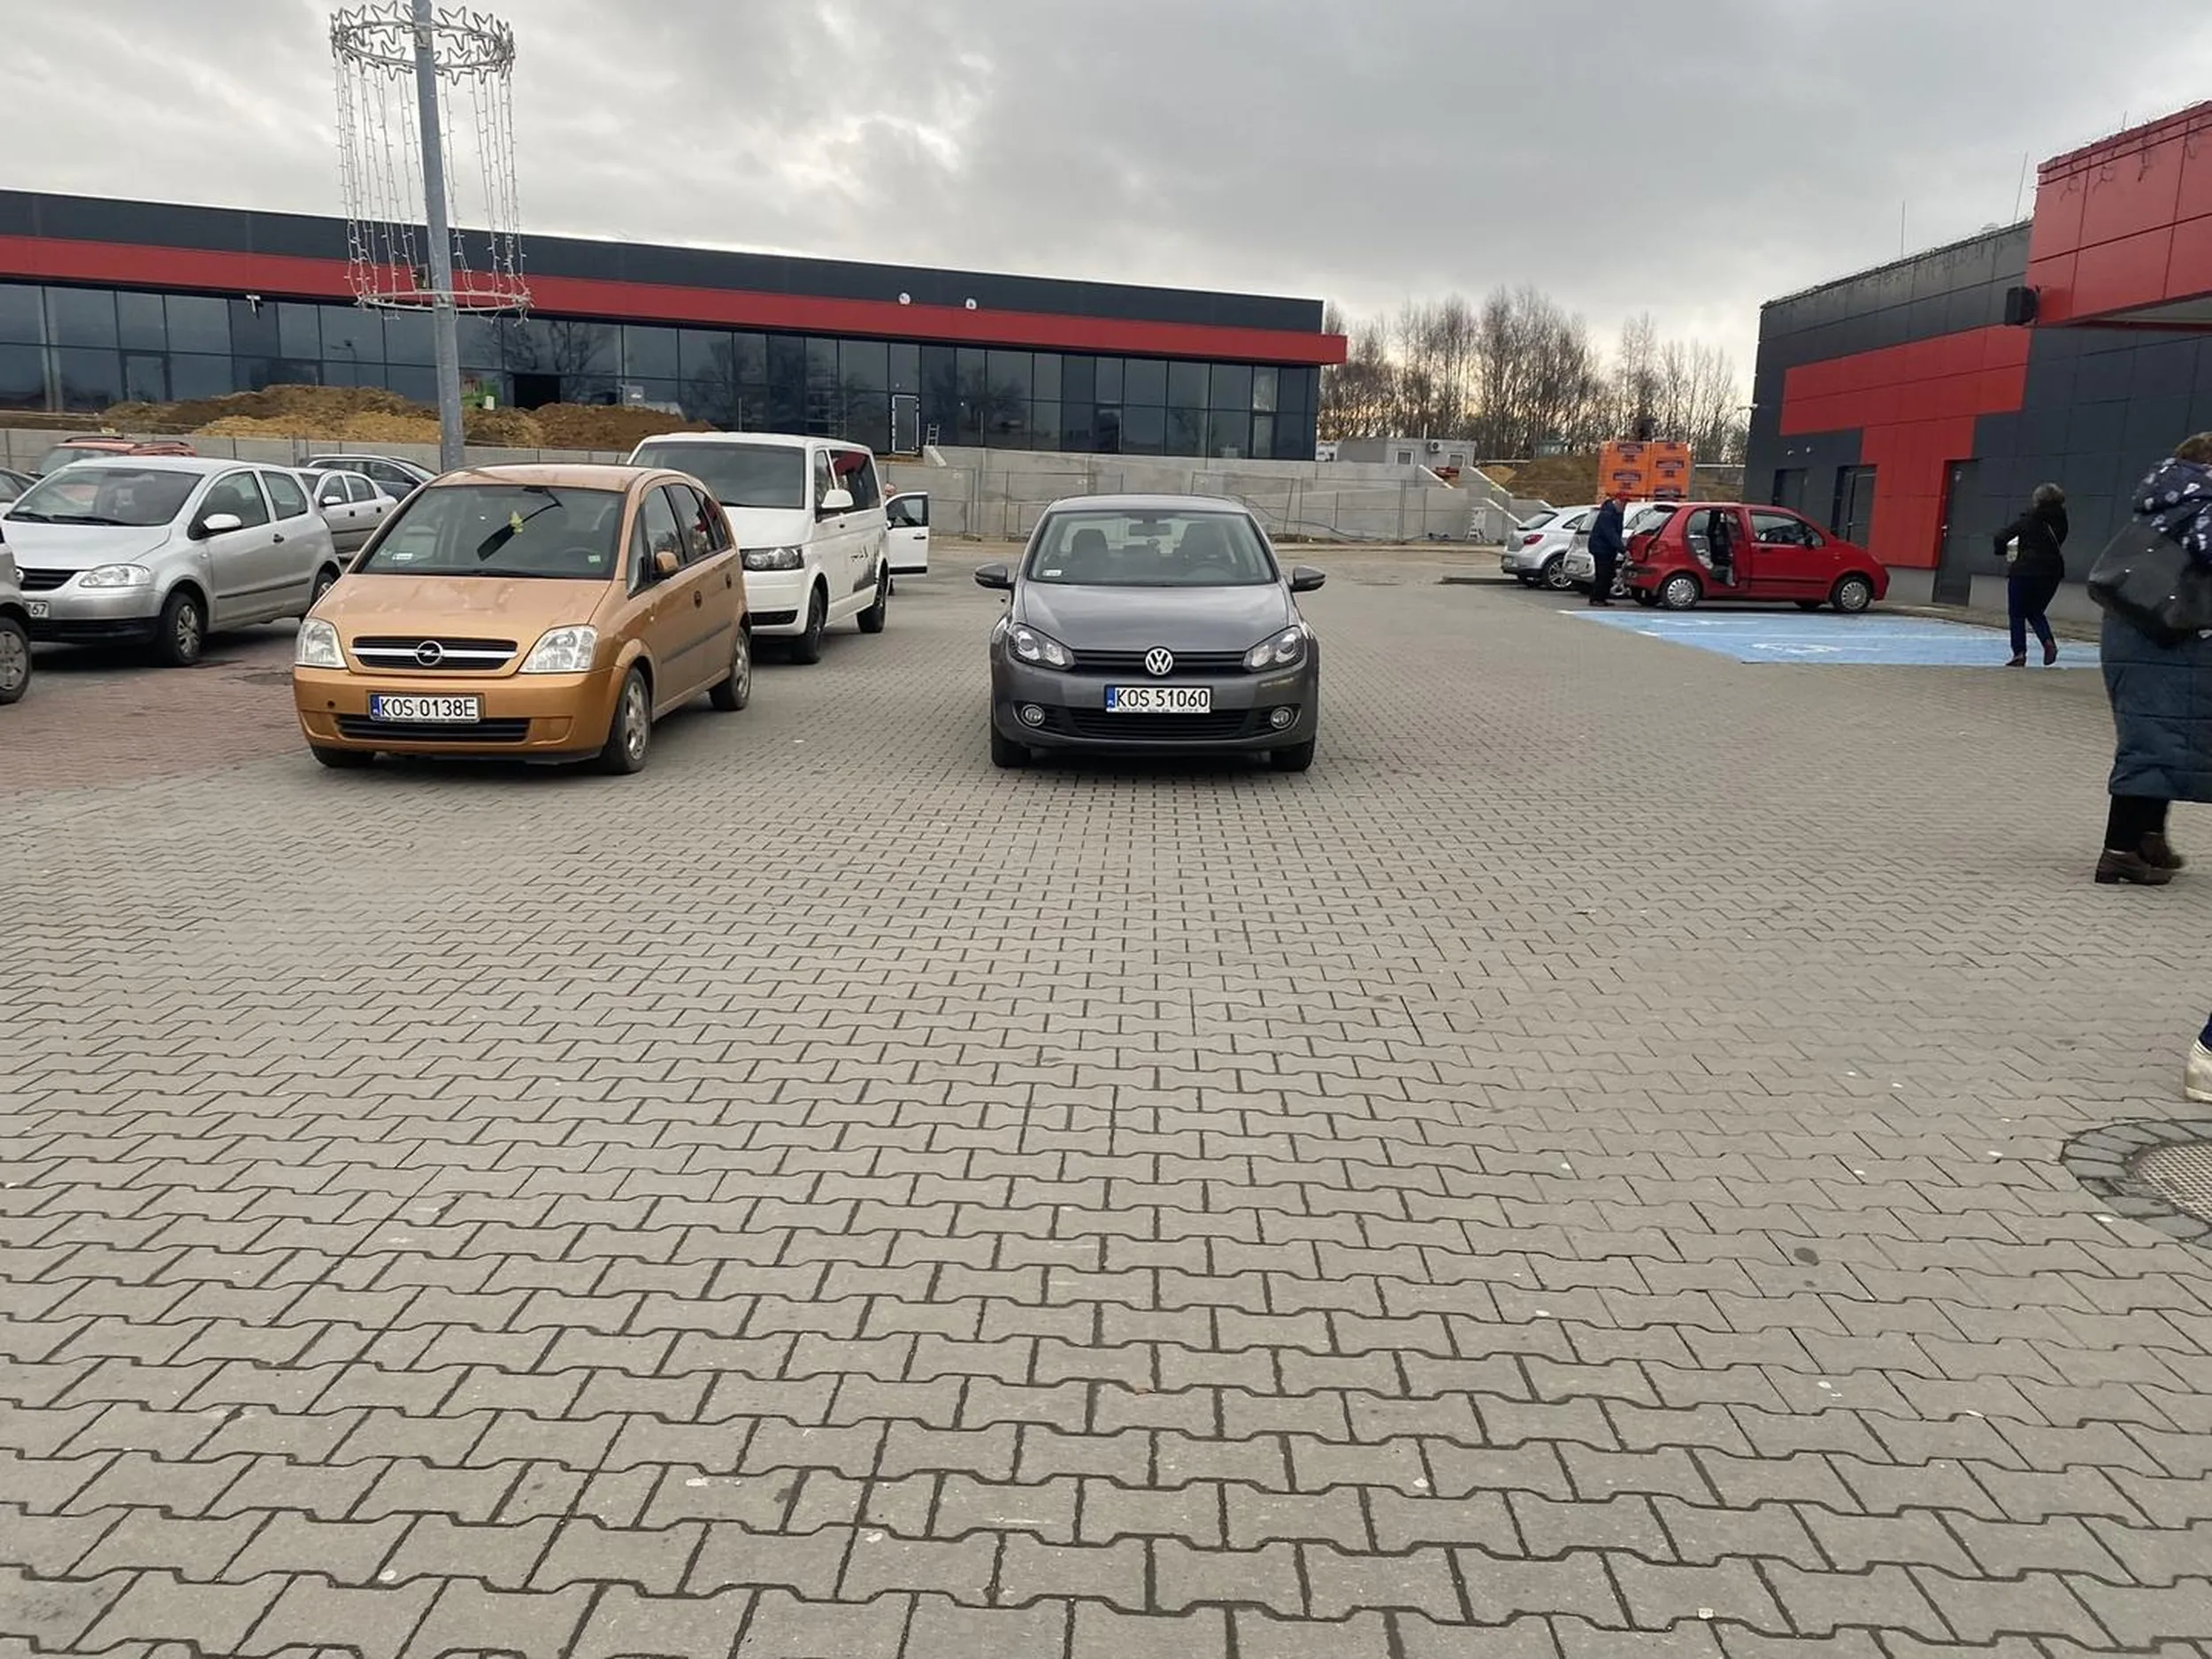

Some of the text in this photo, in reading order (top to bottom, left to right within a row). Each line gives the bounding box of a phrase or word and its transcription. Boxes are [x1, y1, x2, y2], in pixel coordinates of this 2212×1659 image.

[1145, 648, 1173, 675] VW
[380, 698, 476, 717] KOS 0138E
[1116, 689, 1209, 708] KOS 51060
